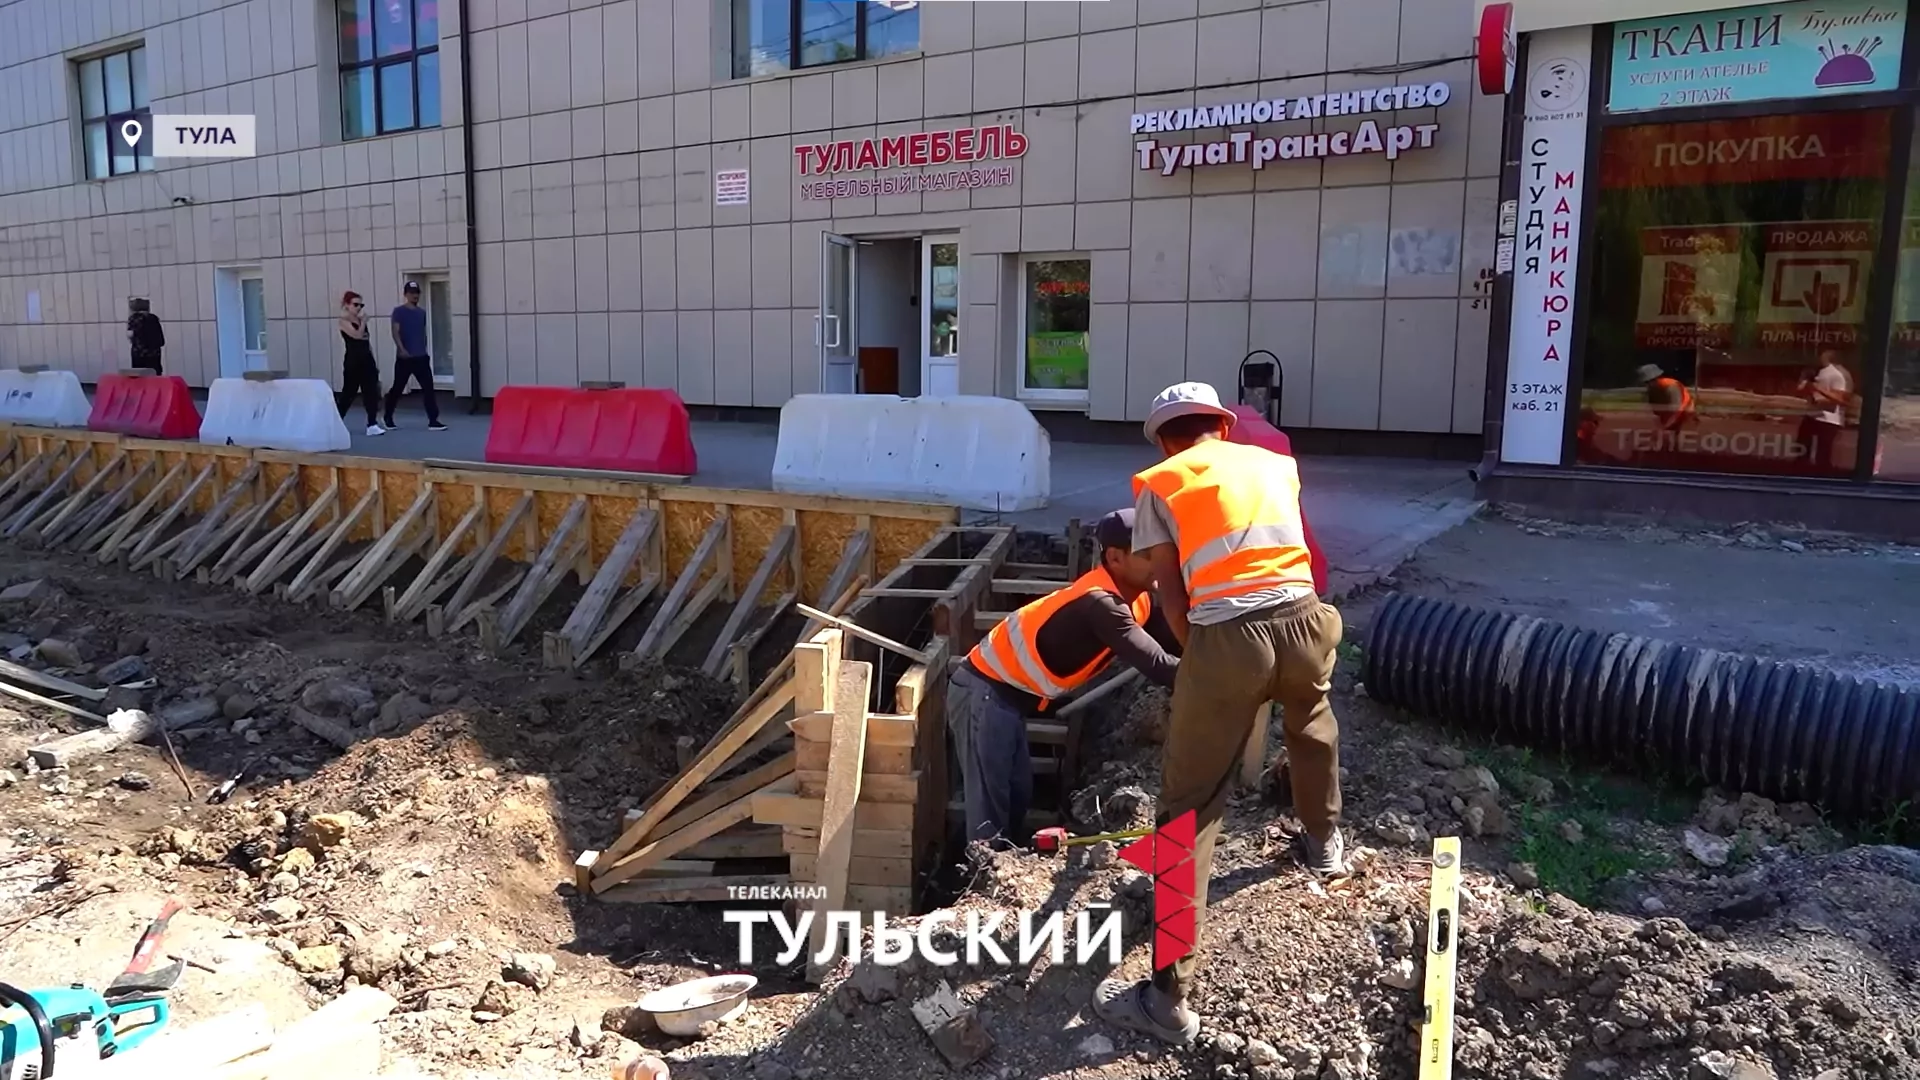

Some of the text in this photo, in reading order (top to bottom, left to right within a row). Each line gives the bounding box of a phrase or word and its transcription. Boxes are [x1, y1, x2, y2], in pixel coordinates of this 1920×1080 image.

[1621, 14, 1782, 61] ТКАНИ
[1629, 61, 1771, 86] УСЛУГИ АТЕЛЬЕ
[1130, 81, 1450, 134] РЕКЛАМНОЕ АГЕНТСТВО
[1660, 86, 1732, 105] 2 ЭТАЖ
[795, 124, 1029, 175] ТУЛАМЕБЕЛЬ
[1136, 119, 1440, 176] ТулаТрансАрт
[1654, 134, 1825, 168] ПОКУПКА
[801, 166, 1013, 199] МЕБЕЛЬНЫЙ МАГАЗИН
[1525, 138, 1549, 274] СТУДИЯ
[1771, 231, 1868, 246] ПРОДАЖА
[1543, 171, 1575, 361] МАНИКЮРА
[1761, 329, 1857, 345] ПЛАНШЕТЫ
[1510, 384, 1563, 395] 3 ЭТАЖ
[1512, 400, 1558, 411] каб. 21
[1613, 428, 1817, 465] ТЕЛЕФОНЫ
